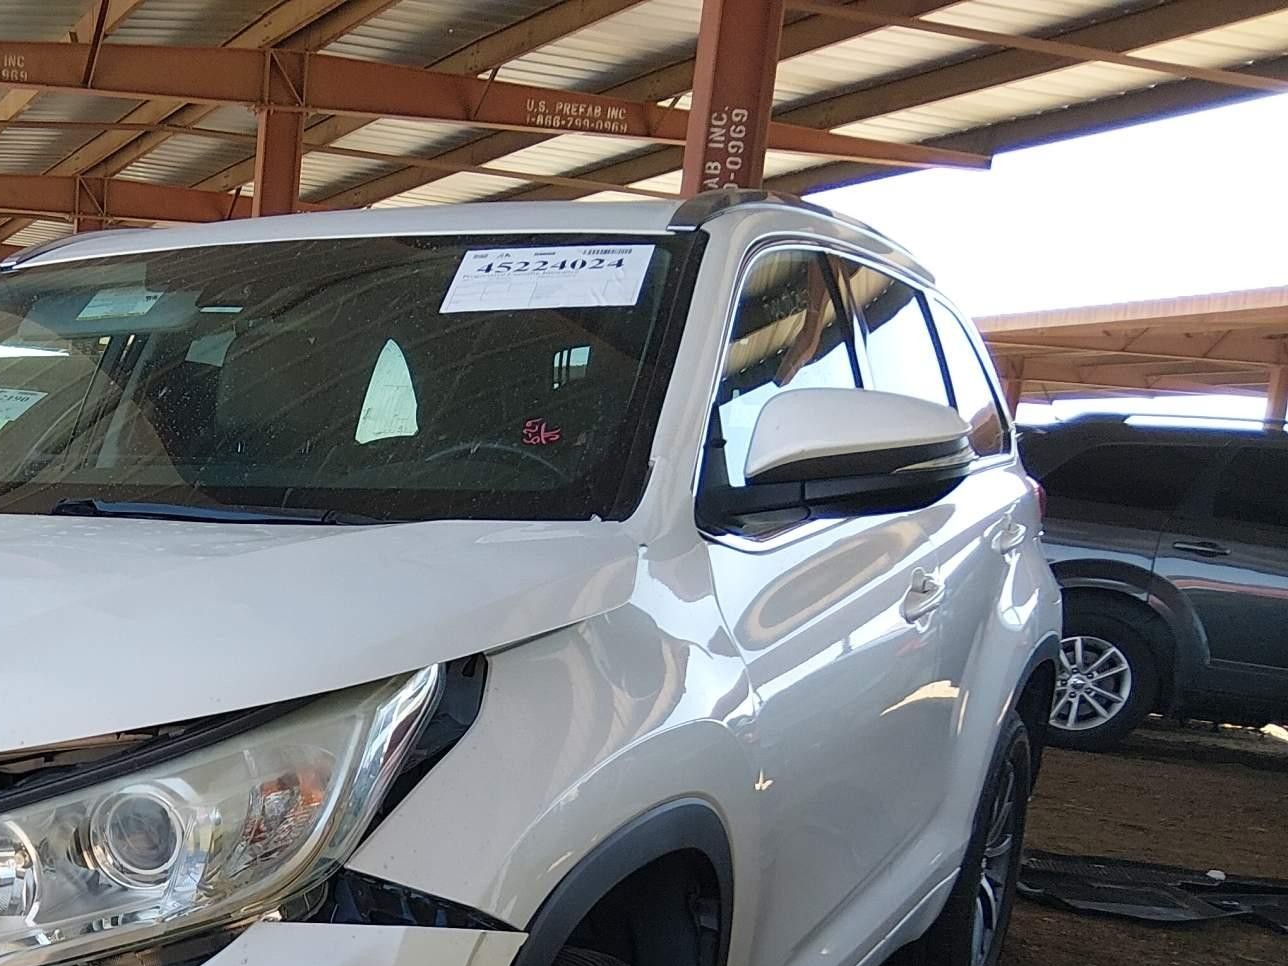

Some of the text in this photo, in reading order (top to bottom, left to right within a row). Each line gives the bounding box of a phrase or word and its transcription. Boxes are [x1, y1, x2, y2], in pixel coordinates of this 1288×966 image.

[525, 99, 550, 114] U.S.
[555, 102, 603, 118] PREFAB
[708, 105, 730, 148] INC.
[475, 257, 627, 275] 45224024
